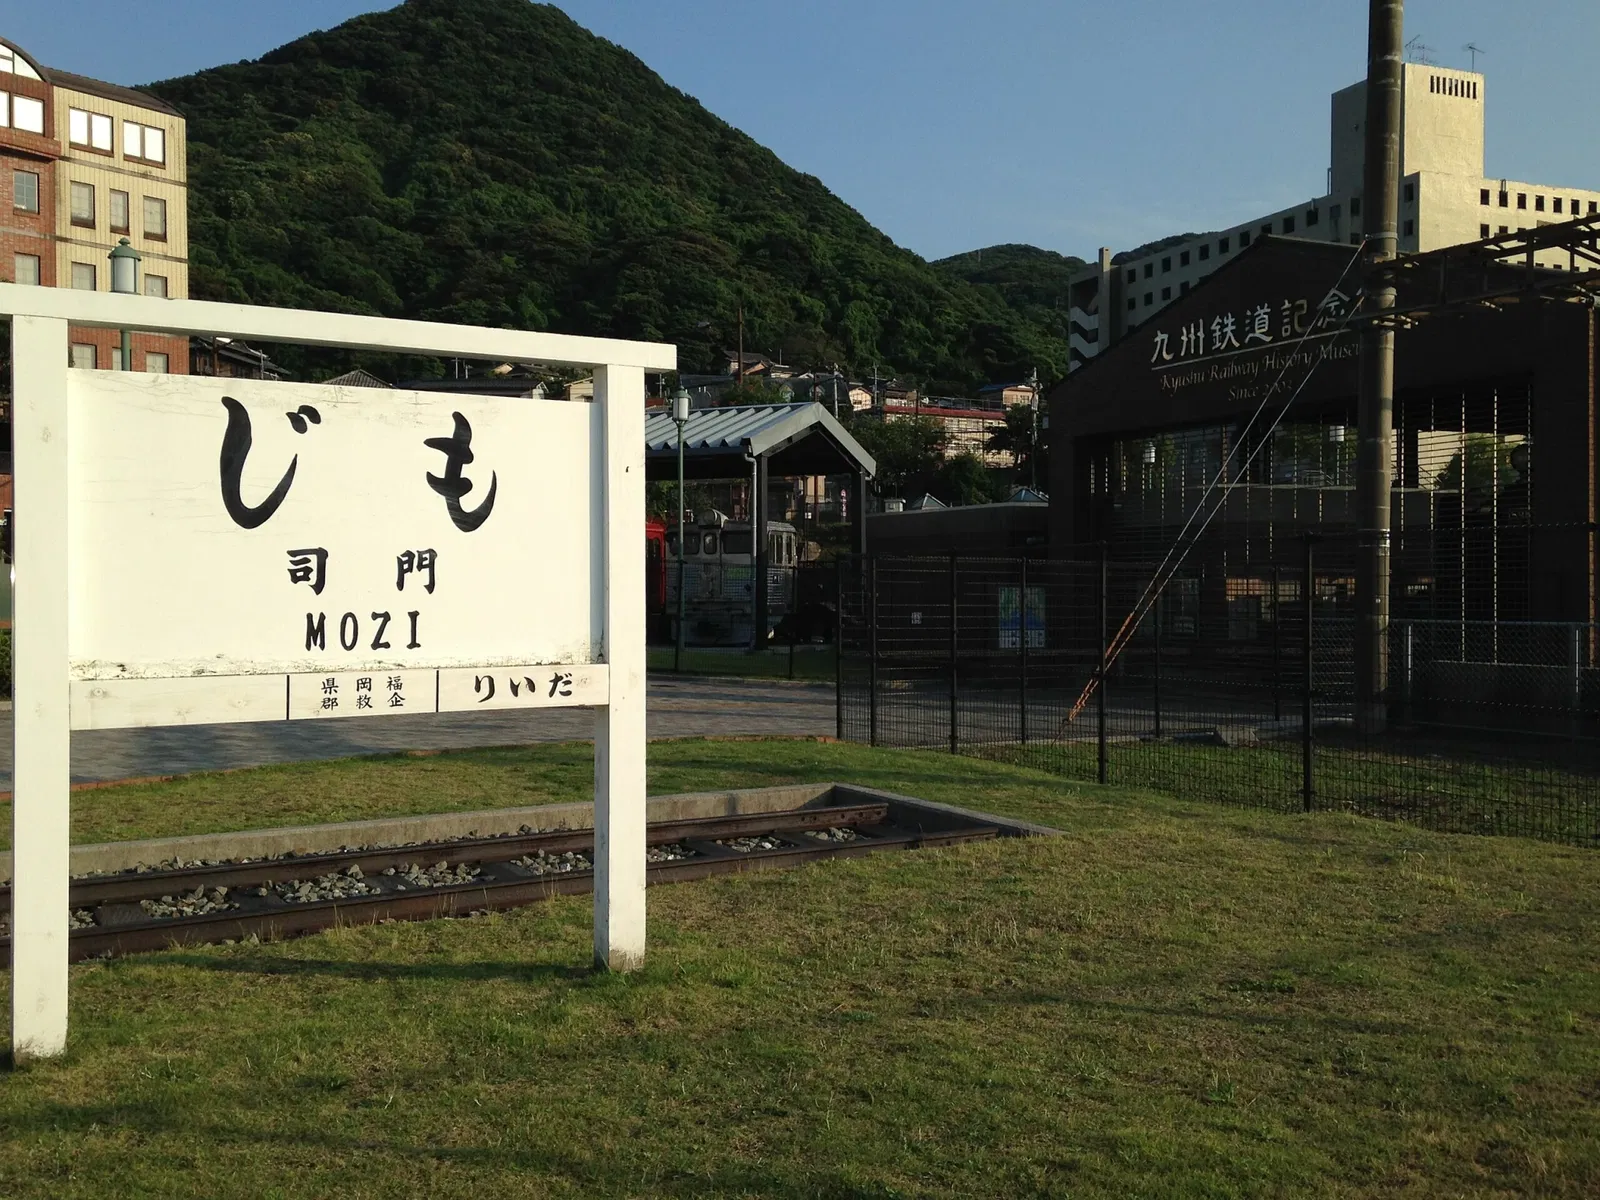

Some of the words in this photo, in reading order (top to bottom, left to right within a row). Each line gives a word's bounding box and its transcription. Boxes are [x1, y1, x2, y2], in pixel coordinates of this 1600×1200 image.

[1151, 286, 1364, 363] 九州鉄道記念
[1160, 372, 1206, 397] Kyushu
[1207, 357, 1260, 382] Railway
[1262, 347, 1313, 372] History
[1316, 343, 1360, 361] Muse
[1228, 383, 1259, 402] Since
[305, 611, 421, 651] MOZI
